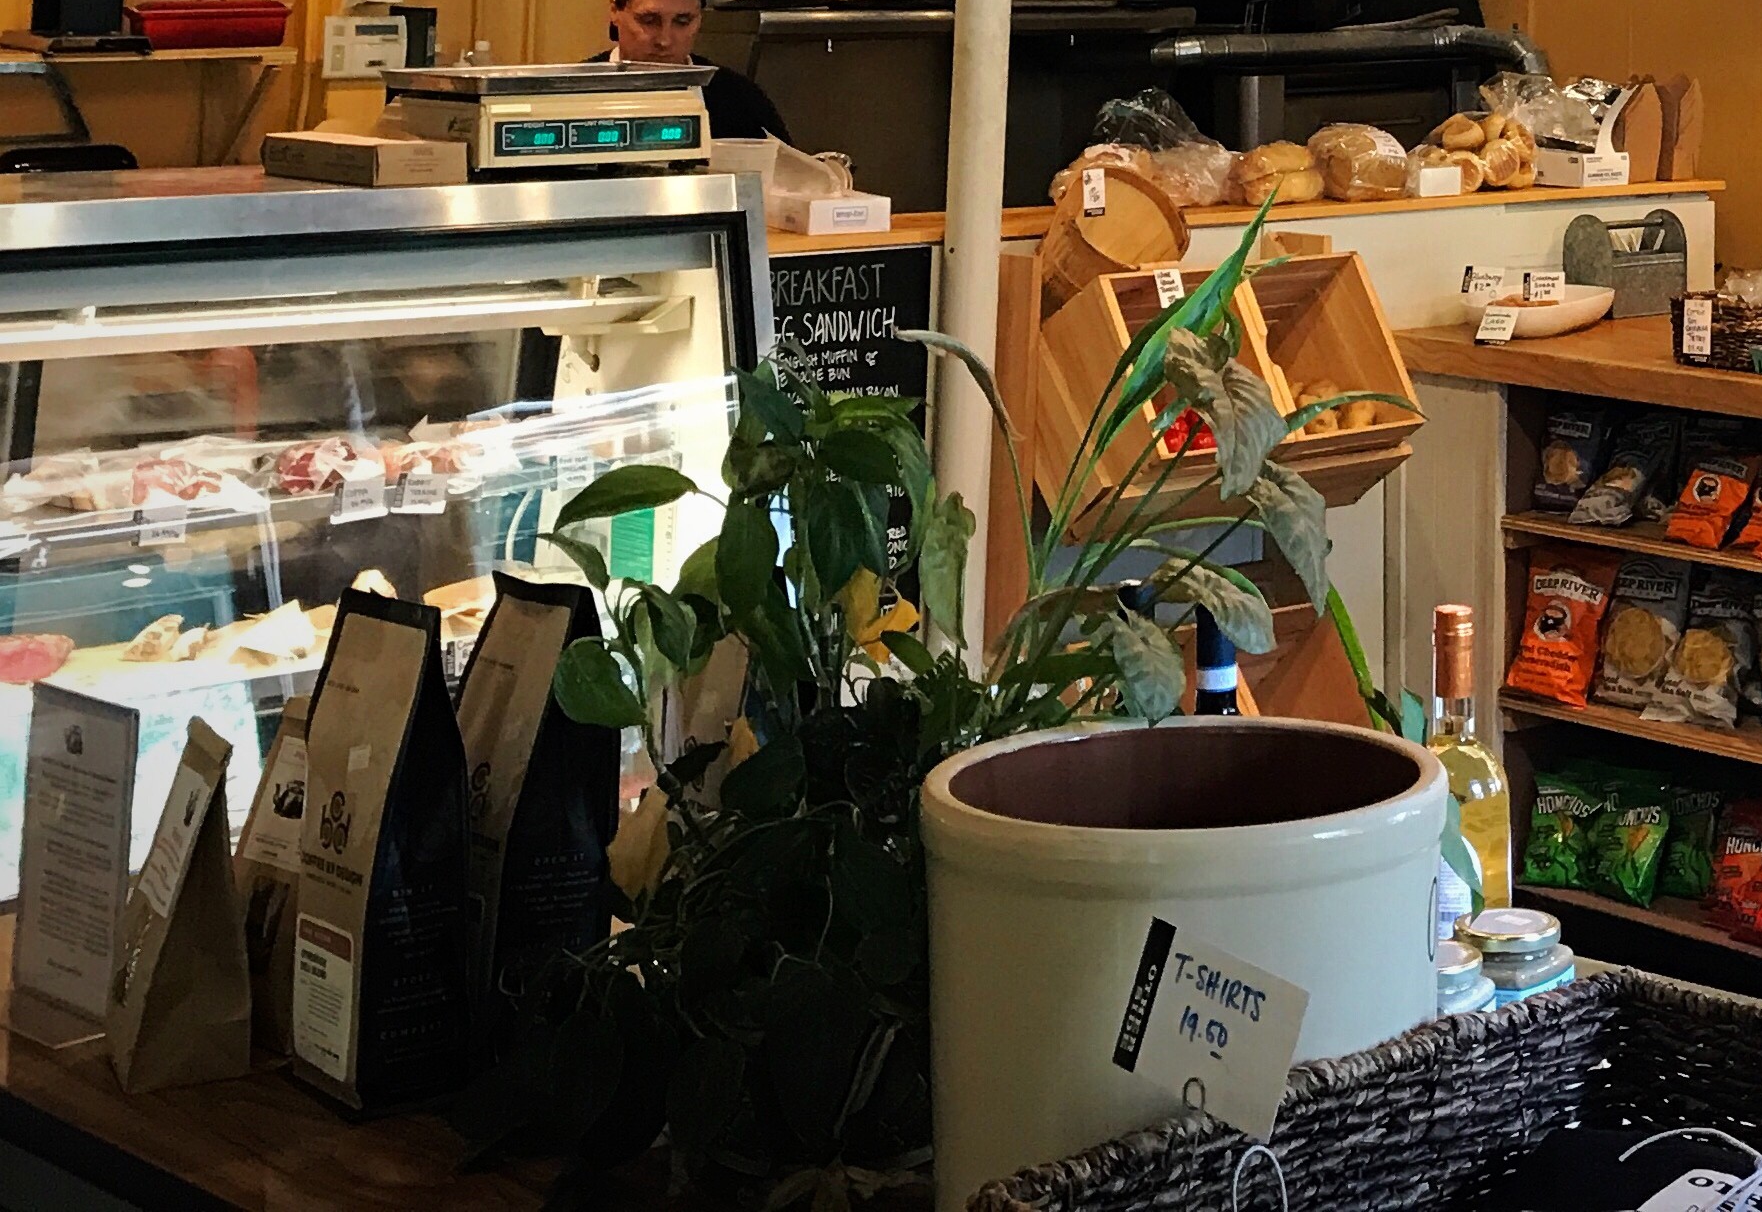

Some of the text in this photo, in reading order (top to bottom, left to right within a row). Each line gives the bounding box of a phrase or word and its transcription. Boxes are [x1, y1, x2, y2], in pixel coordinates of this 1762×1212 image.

[801, 306, 896, 346] SANDWICH
[821, 349, 858, 365] MUFFIN
[828, 367, 851, 382] BUN
[1535, 578, 1601, 602] DEEP RIVER
[1637, 577, 1675, 593] RIVER
[1175, 952, 1267, 1023] T-SHIRTS
[1179, 1005, 1229, 1049] 19.50
